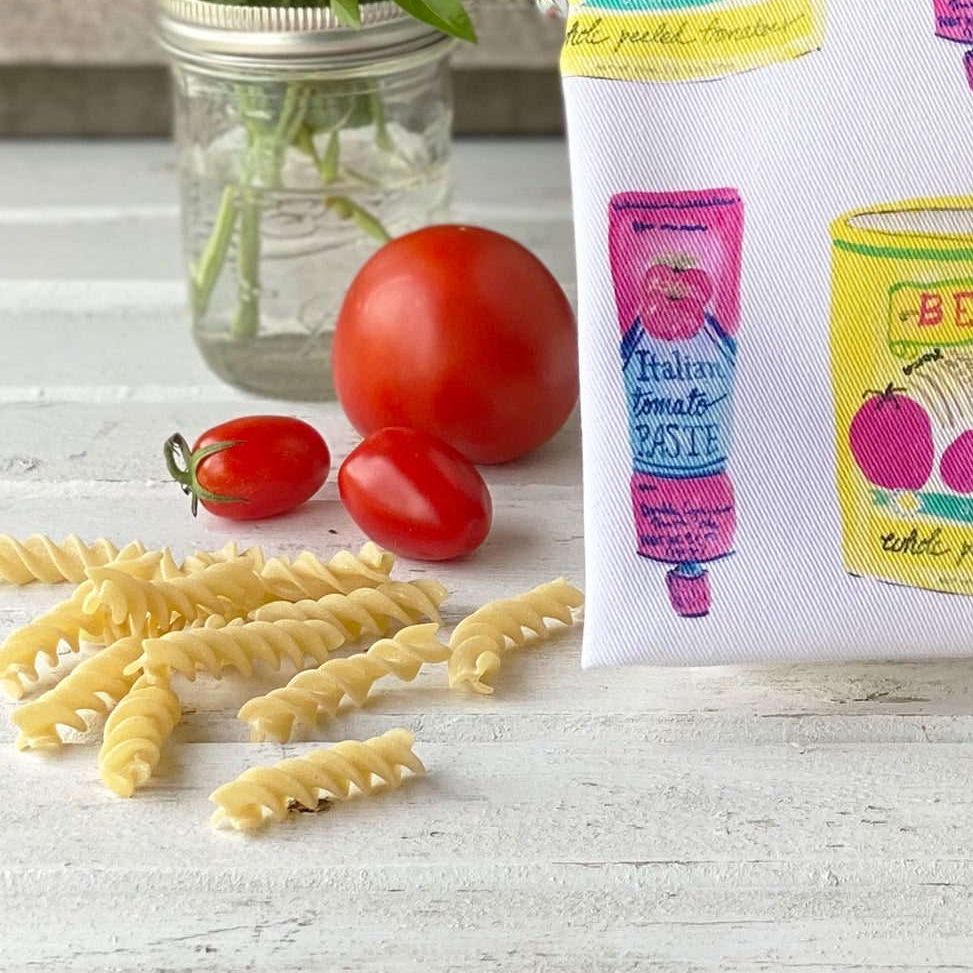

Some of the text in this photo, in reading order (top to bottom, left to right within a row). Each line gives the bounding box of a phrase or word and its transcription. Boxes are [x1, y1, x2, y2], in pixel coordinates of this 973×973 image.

[565, 17, 610, 46] hole
[614, 21, 697, 53] peeled
[635, 349, 726, 382] Italian
[633, 387, 728, 418] tomato
[635, 423, 721, 458] PASTE
